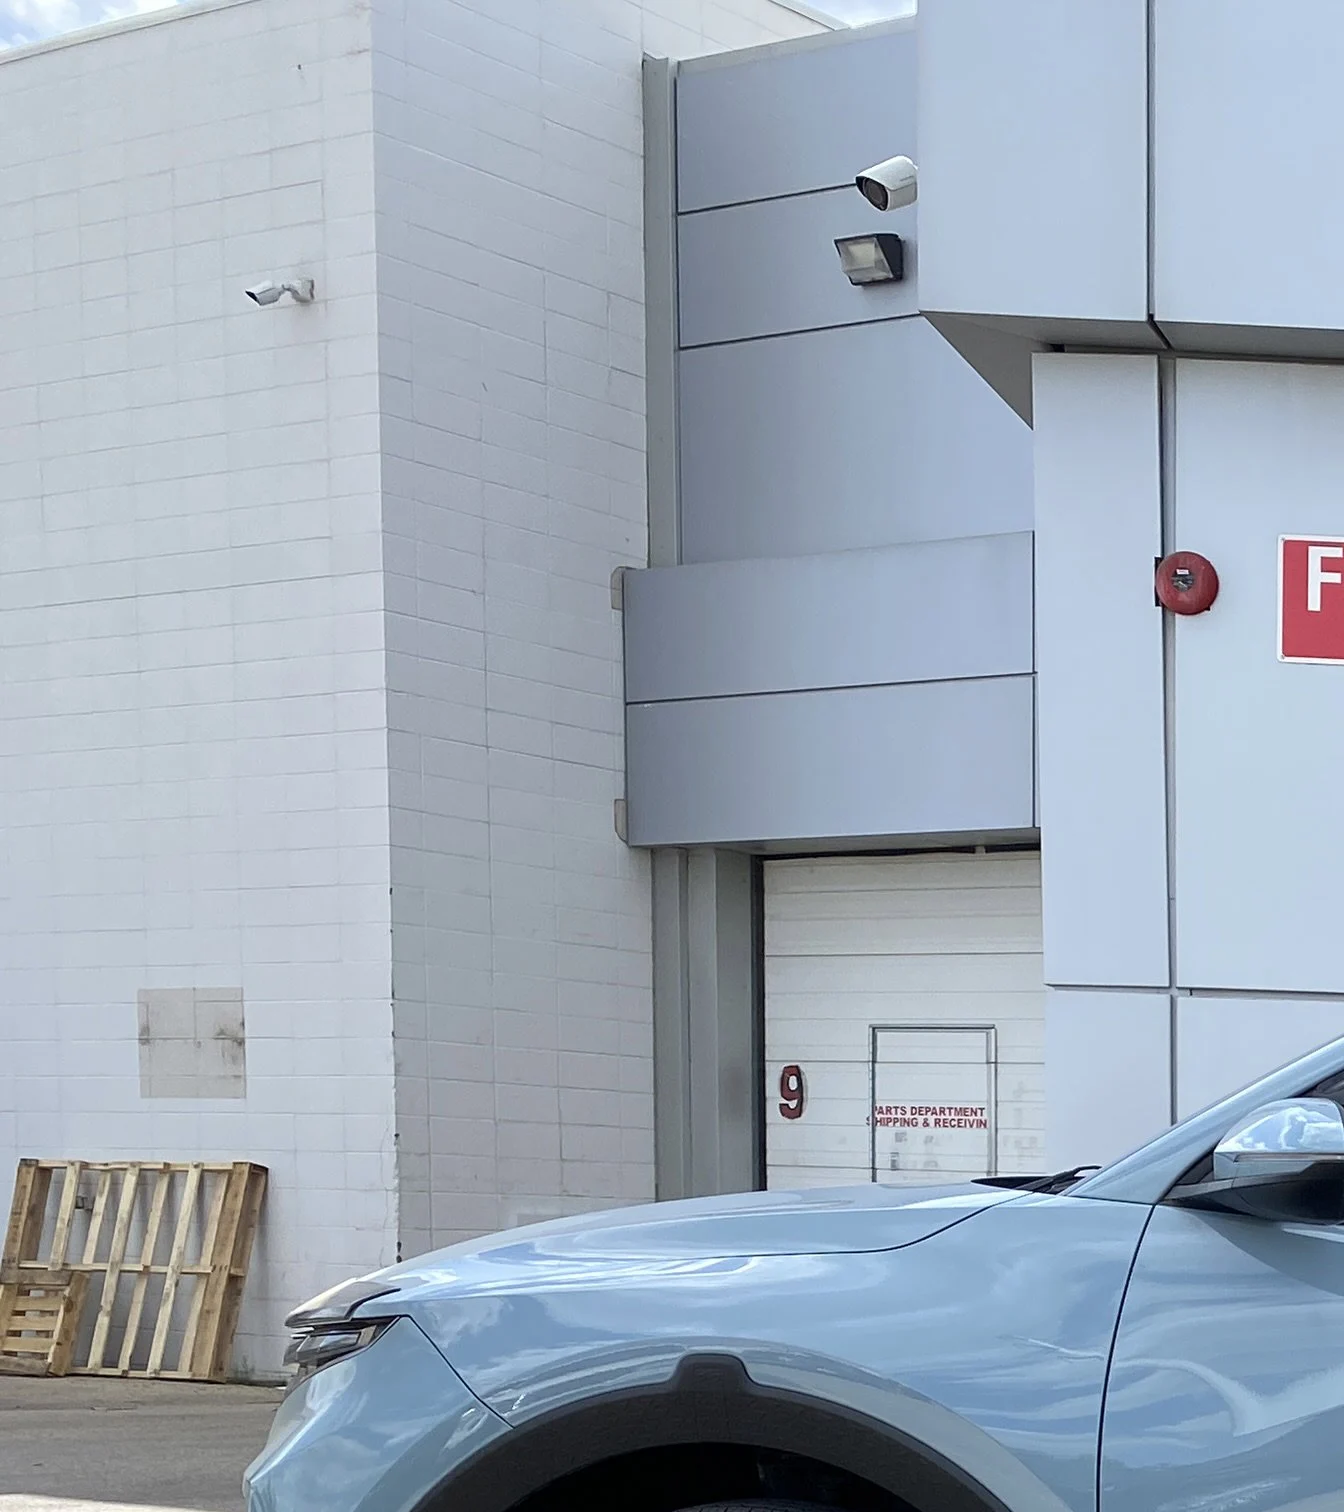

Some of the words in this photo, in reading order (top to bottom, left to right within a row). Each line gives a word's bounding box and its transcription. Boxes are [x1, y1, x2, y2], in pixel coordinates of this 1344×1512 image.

[778, 1064, 804, 1120] 9
[910, 1106, 986, 1117] DEPARTMENT
[922, 1117, 929, 1128] &
